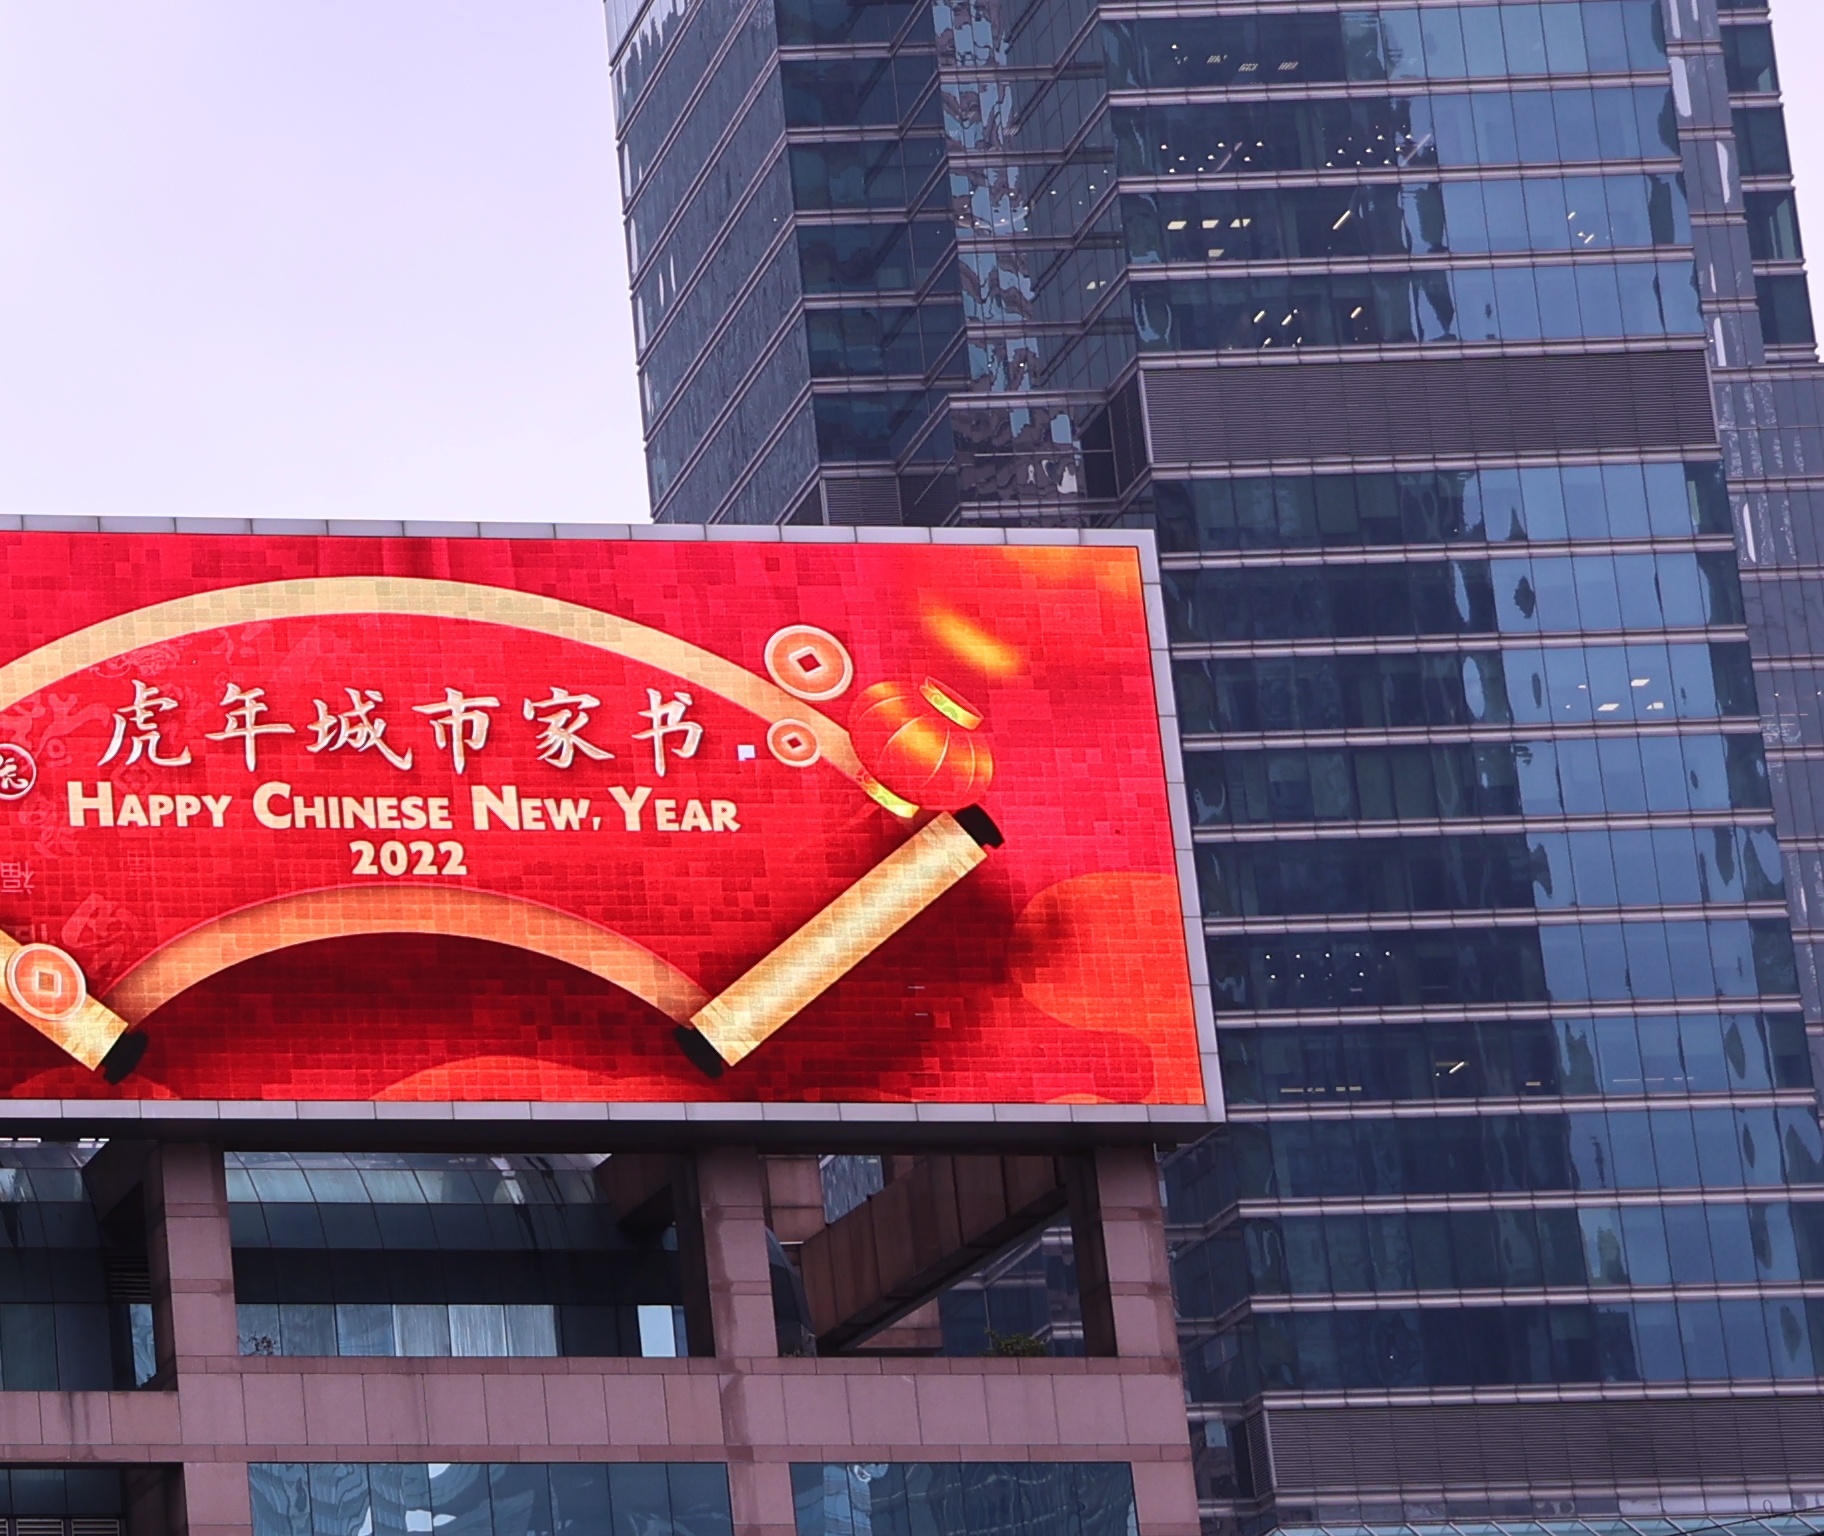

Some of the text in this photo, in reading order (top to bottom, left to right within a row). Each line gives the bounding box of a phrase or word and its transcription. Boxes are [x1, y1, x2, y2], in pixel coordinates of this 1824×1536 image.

[96, 680, 705, 777] 虎年城市家书
[252, 783, 454, 831] CHINESE
[607, 786, 742, 834] YEAR
[351, 841, 467, 875] 2022
